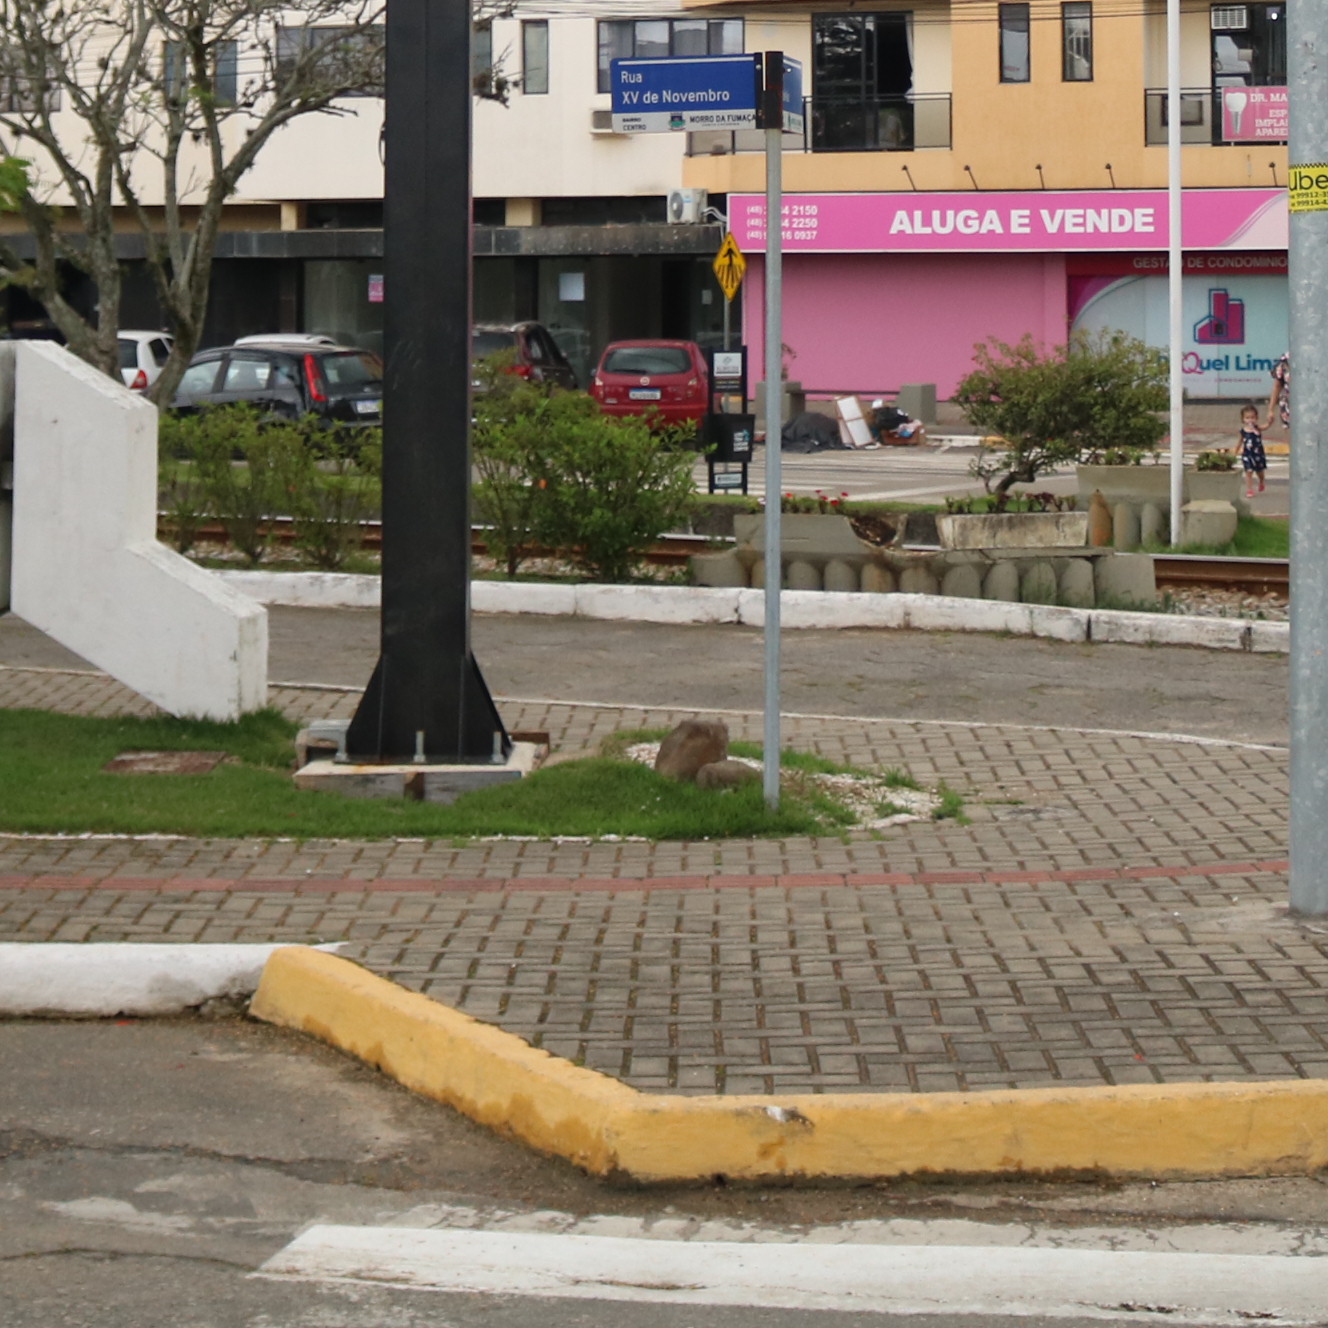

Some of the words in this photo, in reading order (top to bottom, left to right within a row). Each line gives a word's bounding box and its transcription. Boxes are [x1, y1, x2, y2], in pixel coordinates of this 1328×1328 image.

[621, 71, 642, 84] Rua
[622, 91, 639, 105] XV
[643, 90, 659, 104] de
[662, 88, 730, 103] Novembro
[1250, 93, 1267, 102] DR.
[690, 115, 714, 123] MORRO
[716, 115, 725, 123] DA
[727, 113, 756, 123] FUMAÇA
[792, 205, 818, 215] 2150
[792, 218, 818, 228] 2250
[888, 210, 1003, 234] ALUGA
[1010, 210, 1031, 234] E
[1040, 208, 1154, 234] VENDE
[1187, 257, 1204, 268] DE
